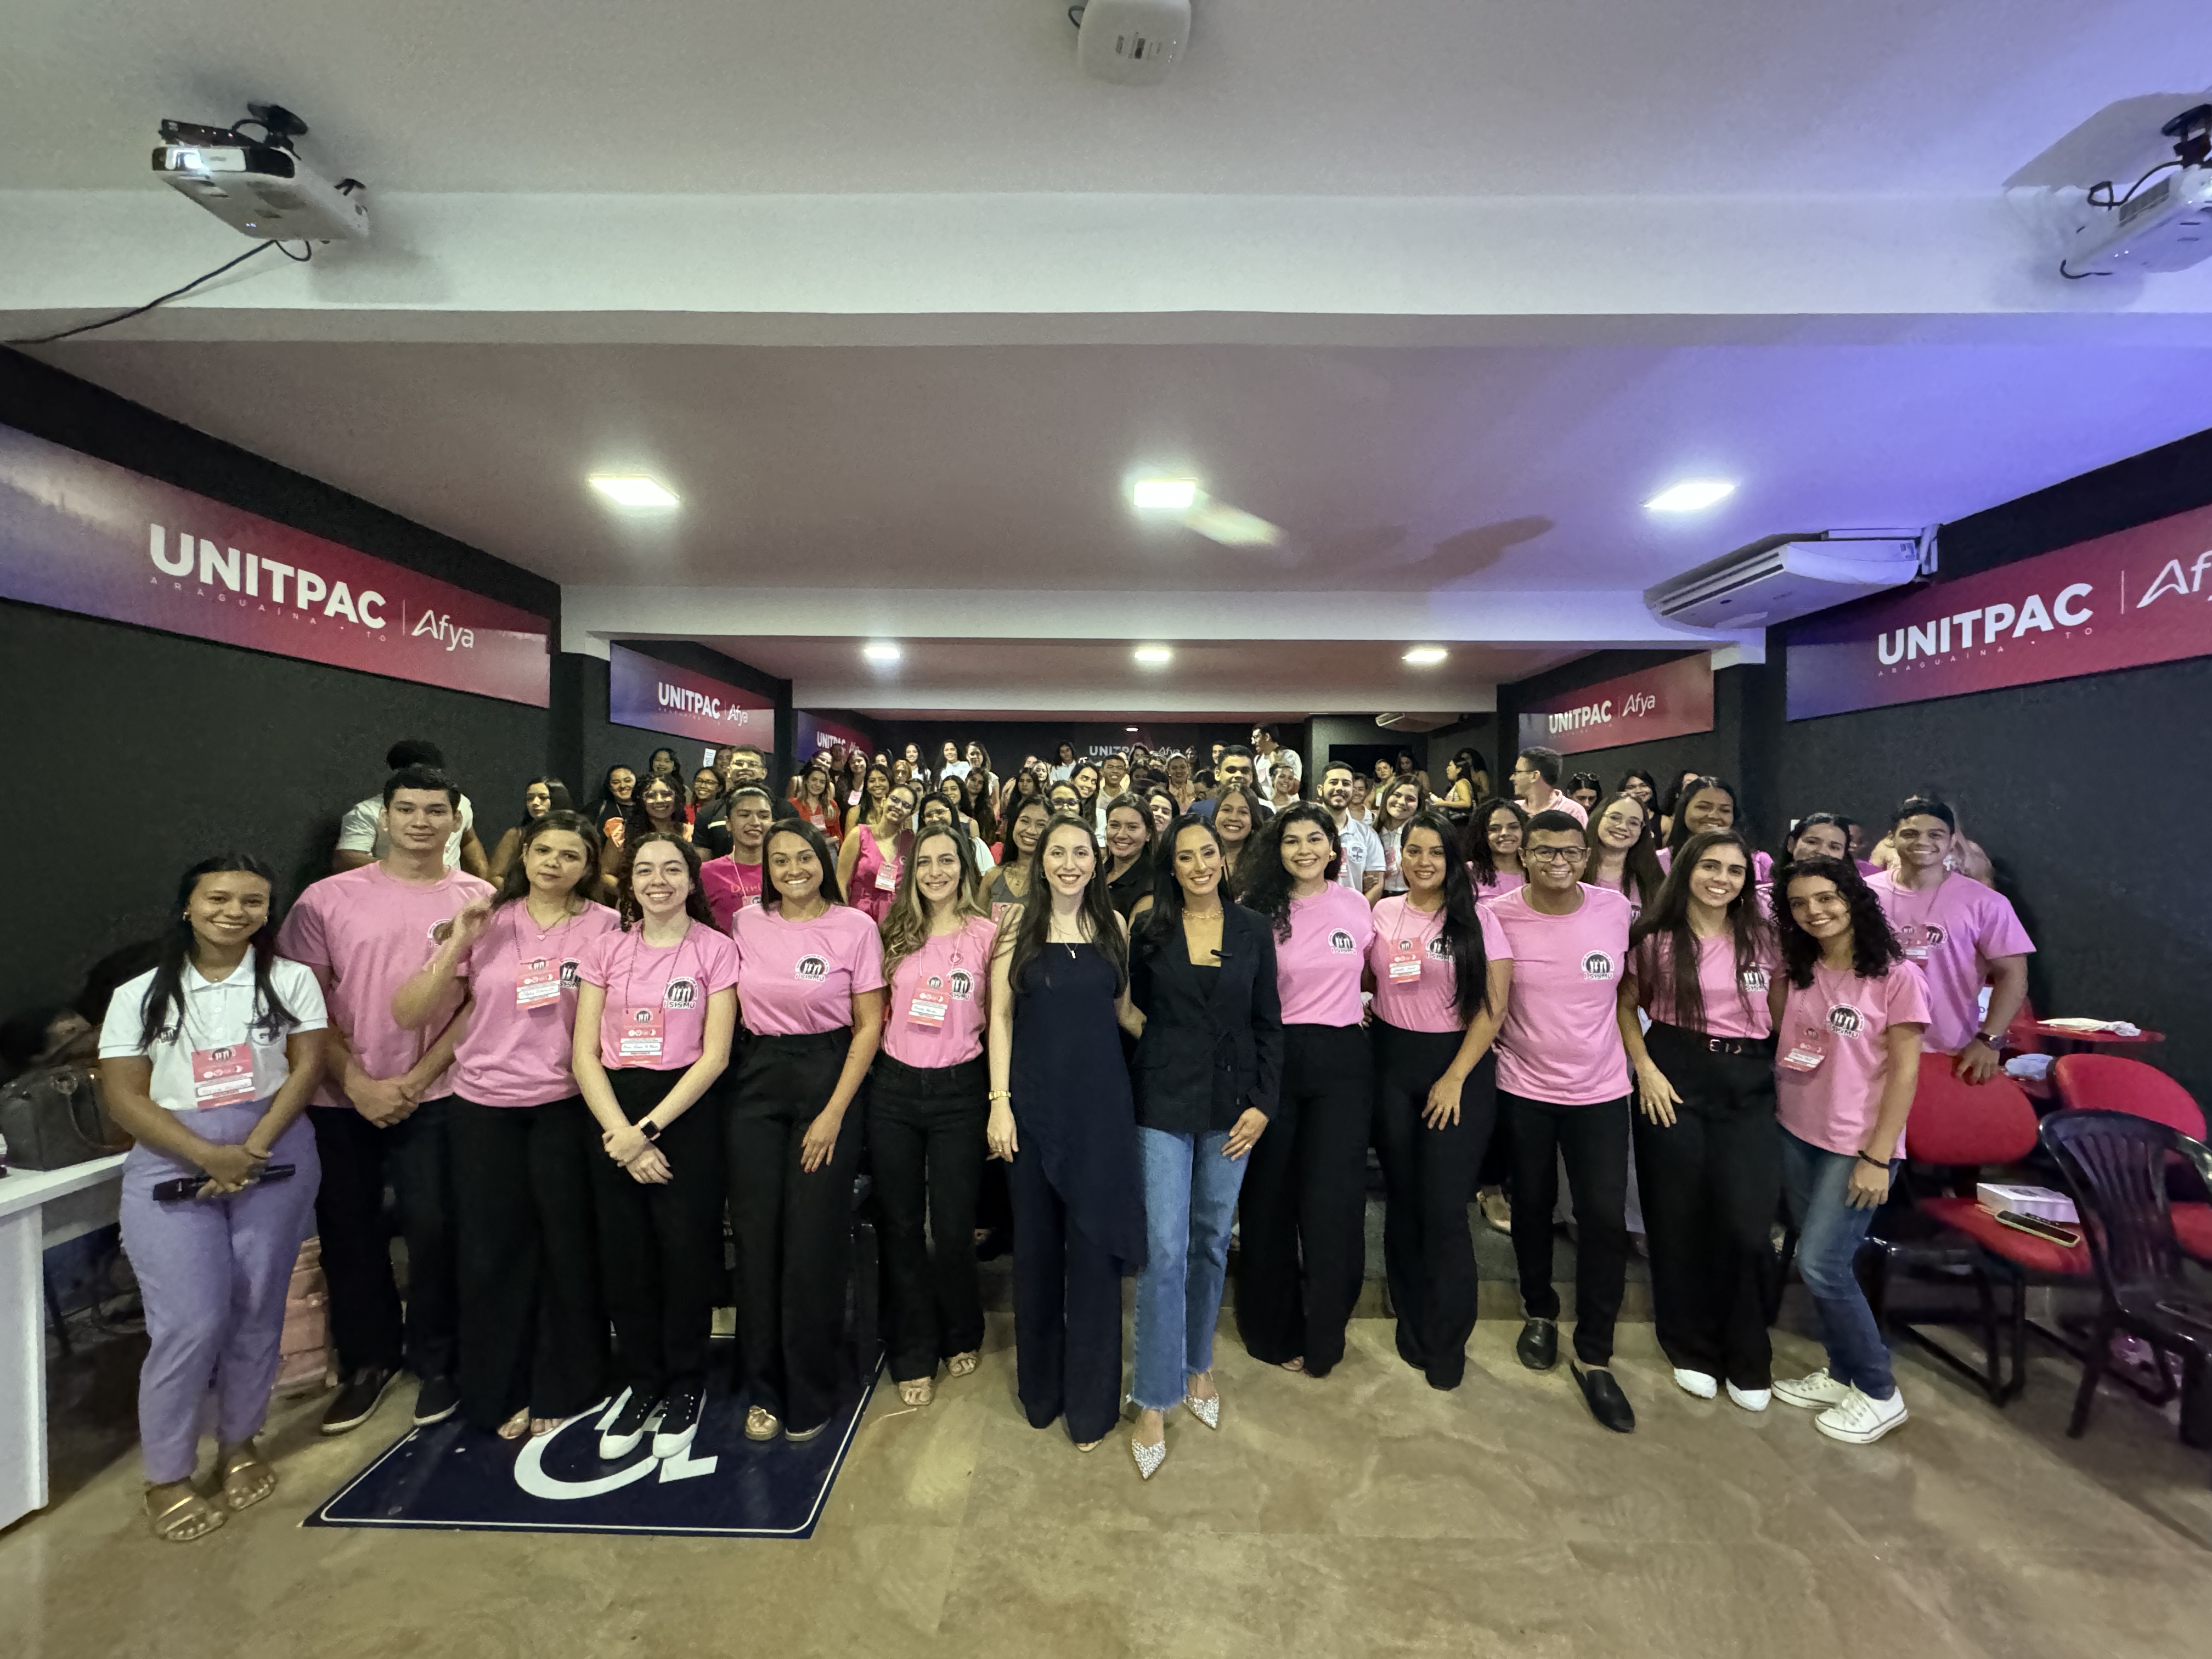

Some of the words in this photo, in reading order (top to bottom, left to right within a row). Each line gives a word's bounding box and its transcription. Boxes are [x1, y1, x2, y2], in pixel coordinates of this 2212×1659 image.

[150, 523, 387, 629] UNITPAC
[411, 610, 474, 651] Afya
[1878, 583, 2094, 665] UNITPAC
[2136, 550, 2212, 608] Af
[658, 681, 721, 719] UNITPAC
[727, 704, 748, 727] Afya
[1549, 699, 1612, 734] UNITPAC
[1622, 692, 1656, 717] Afya
[668, 1001, 696, 1009] SISMU
